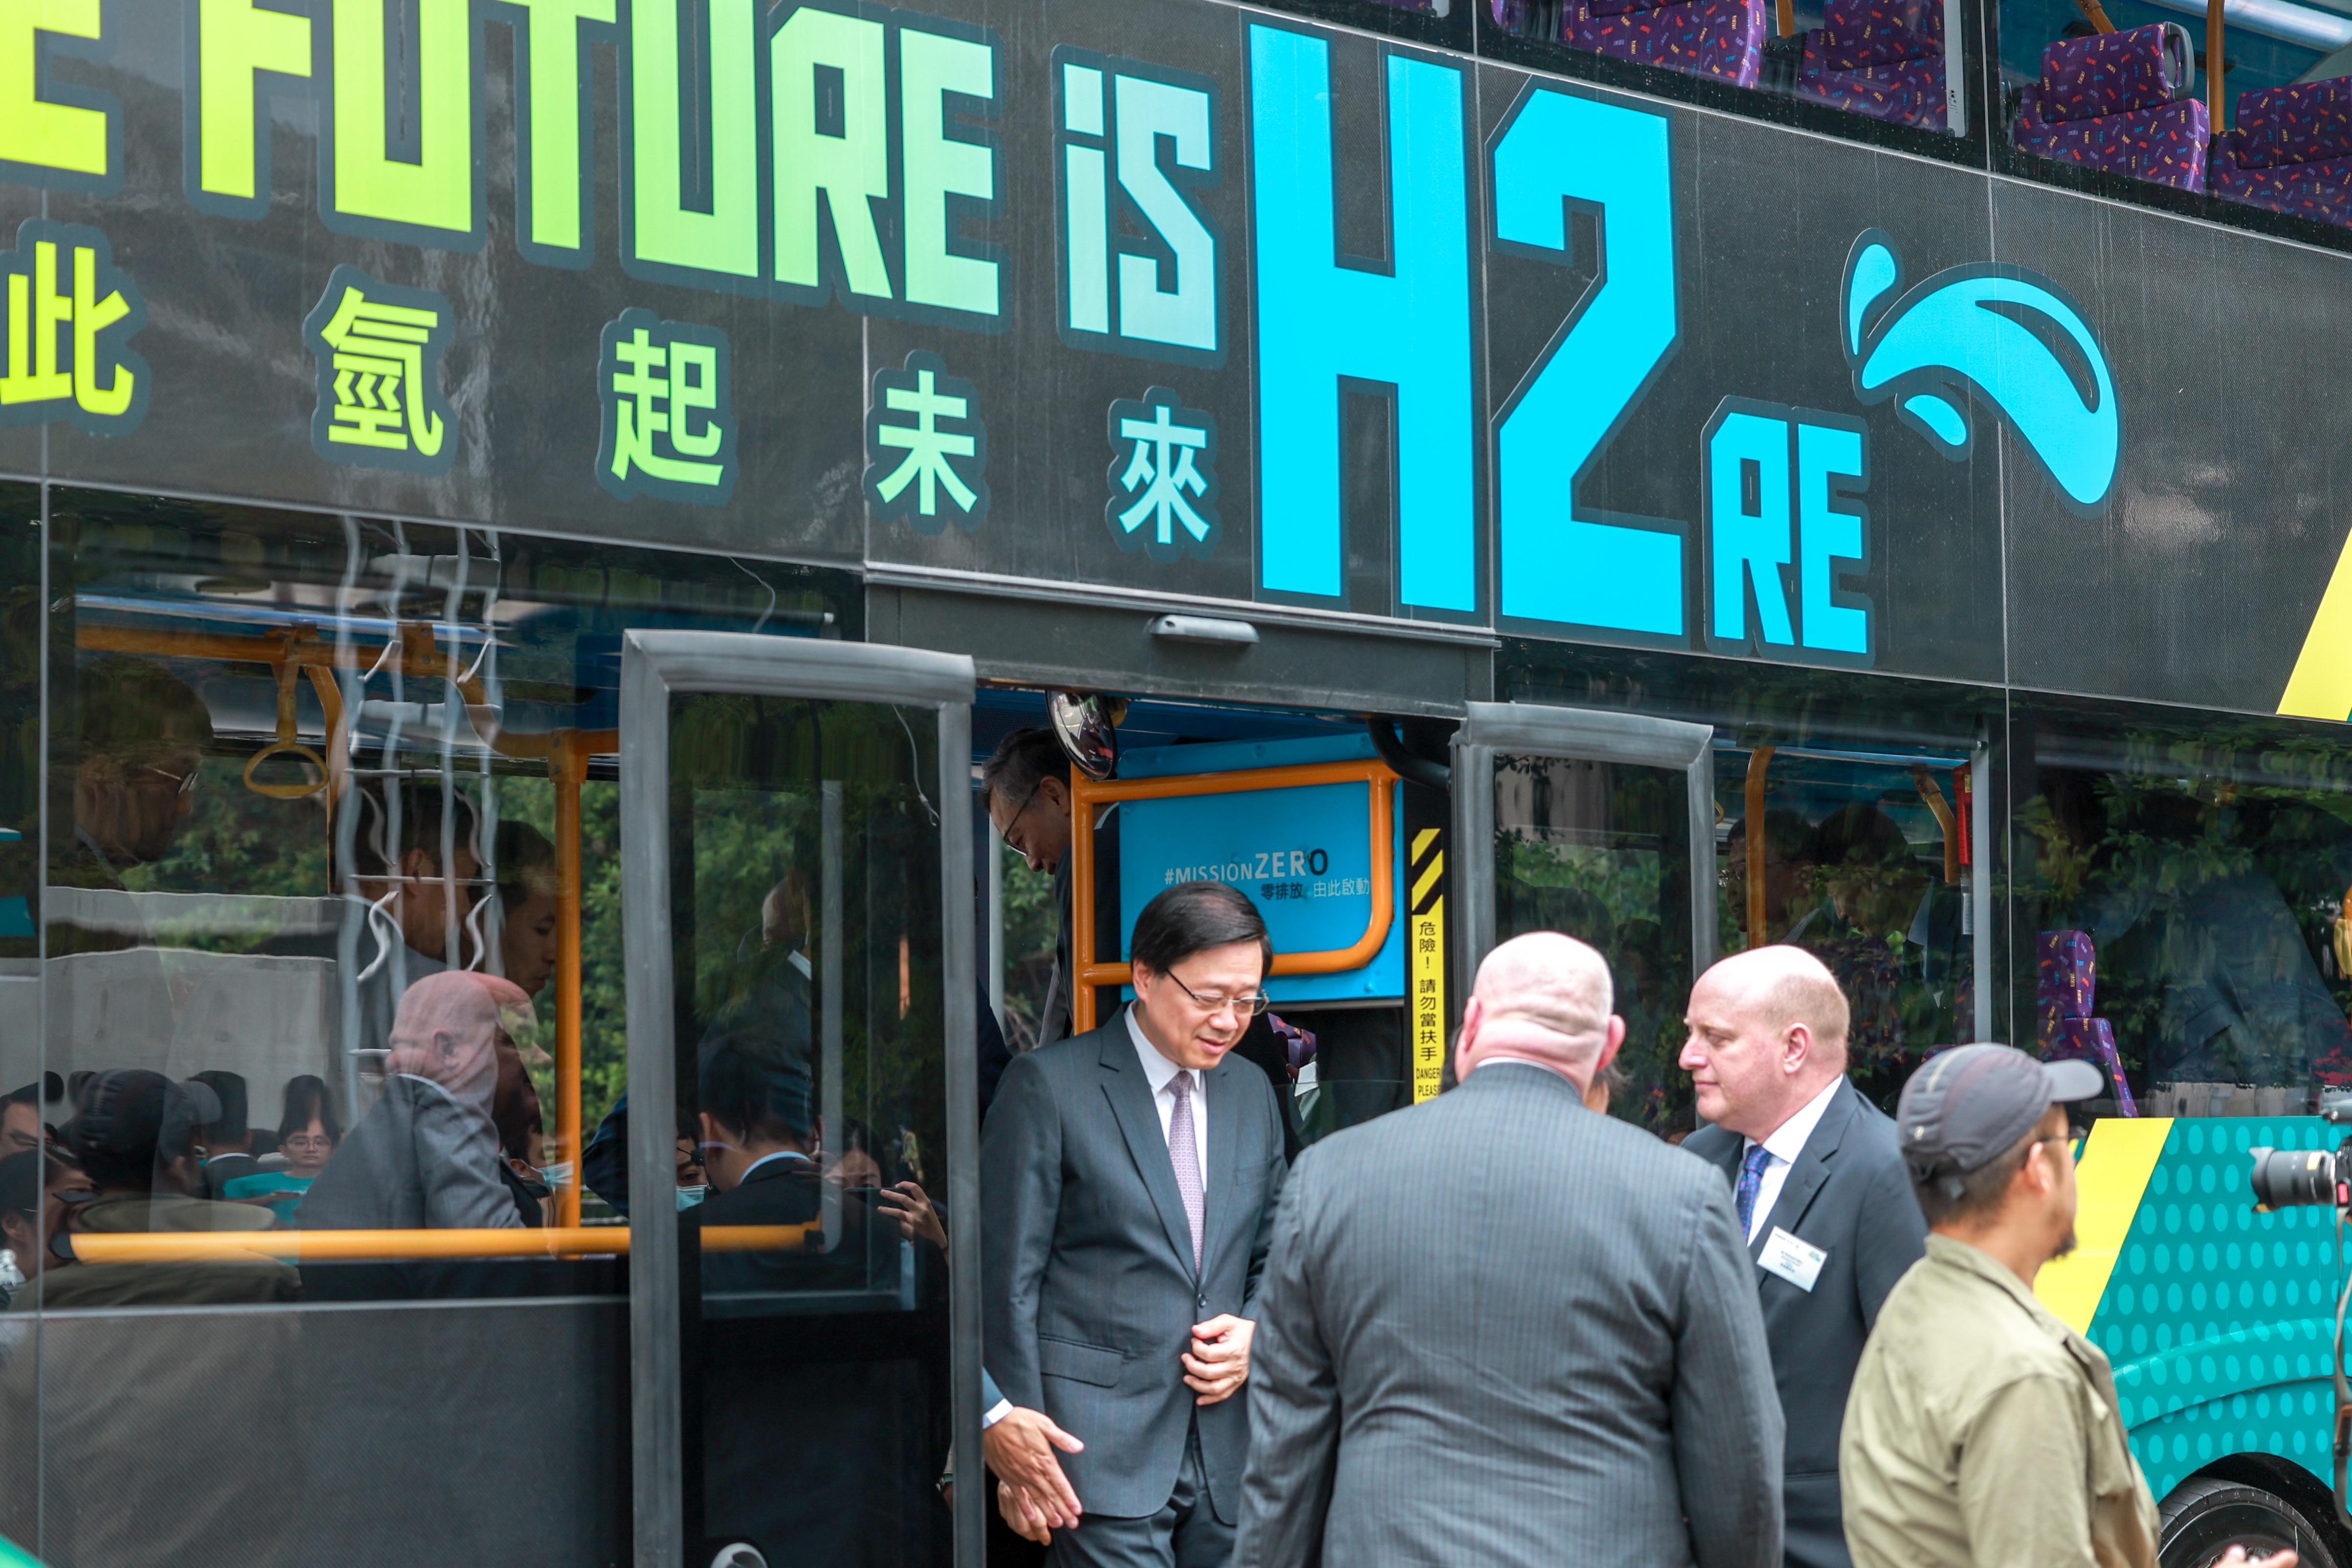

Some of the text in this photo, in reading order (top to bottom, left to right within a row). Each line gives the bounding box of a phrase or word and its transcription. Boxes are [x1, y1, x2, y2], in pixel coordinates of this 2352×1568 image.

[200, 0, 1000, 316] FUTURE
[1260, 882, 1303, 900] 零排放
